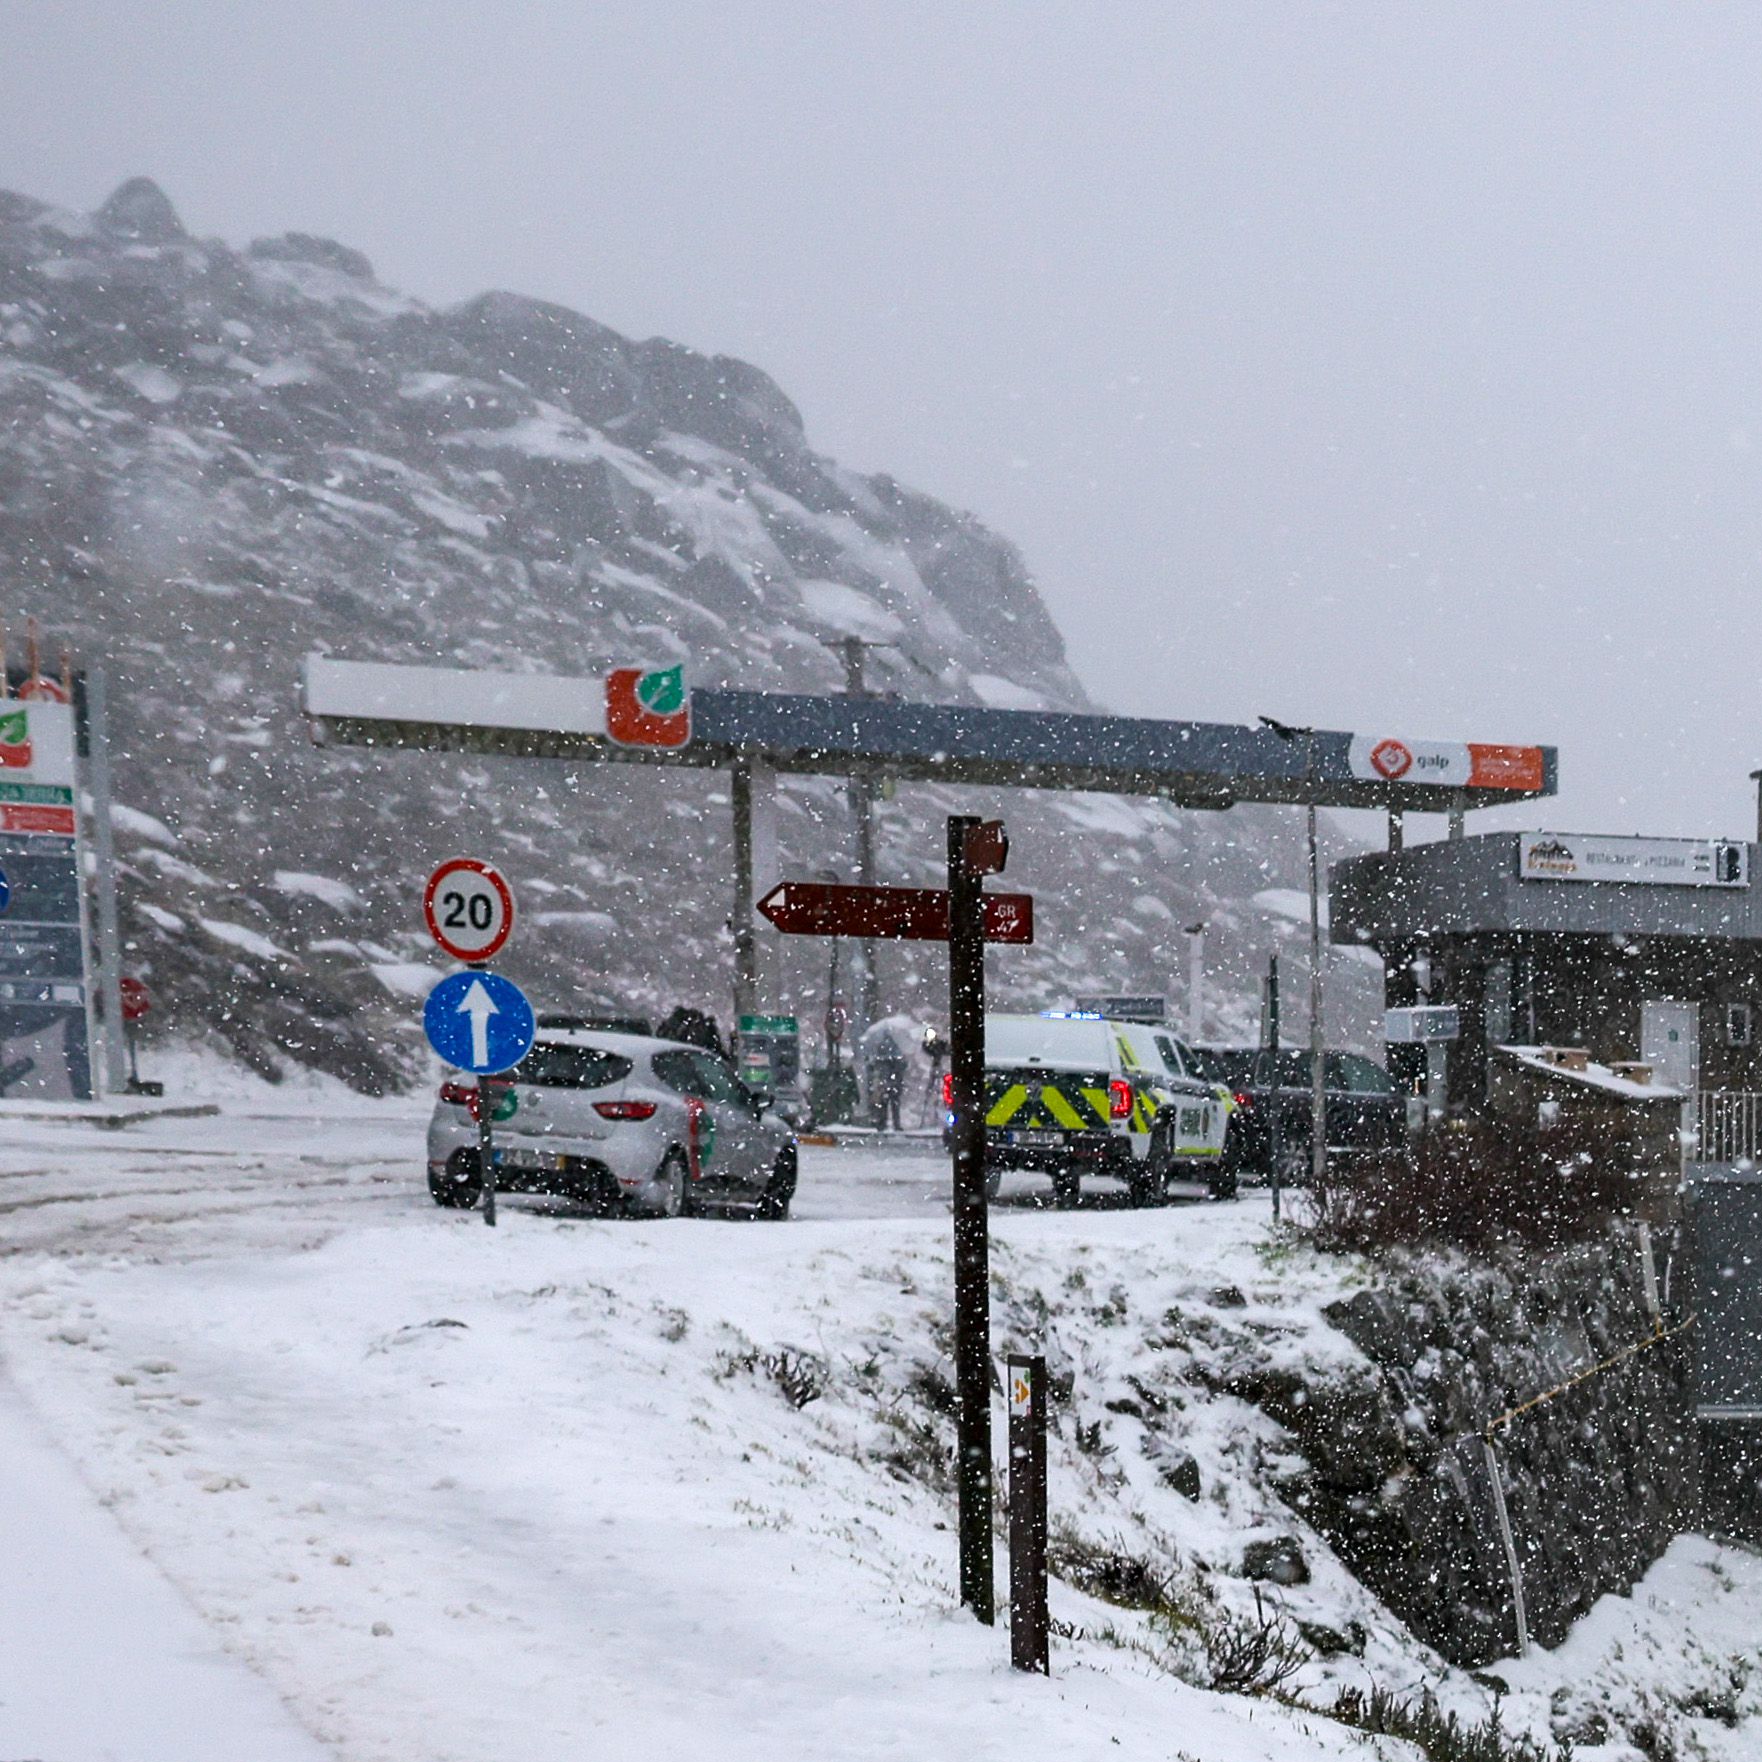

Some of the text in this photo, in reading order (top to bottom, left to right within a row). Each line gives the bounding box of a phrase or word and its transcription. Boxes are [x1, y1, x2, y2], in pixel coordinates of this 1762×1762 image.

[1416, 753, 1450, 770] galp
[443, 891, 493, 931] 20
[997, 904, 1017, 919] GR
